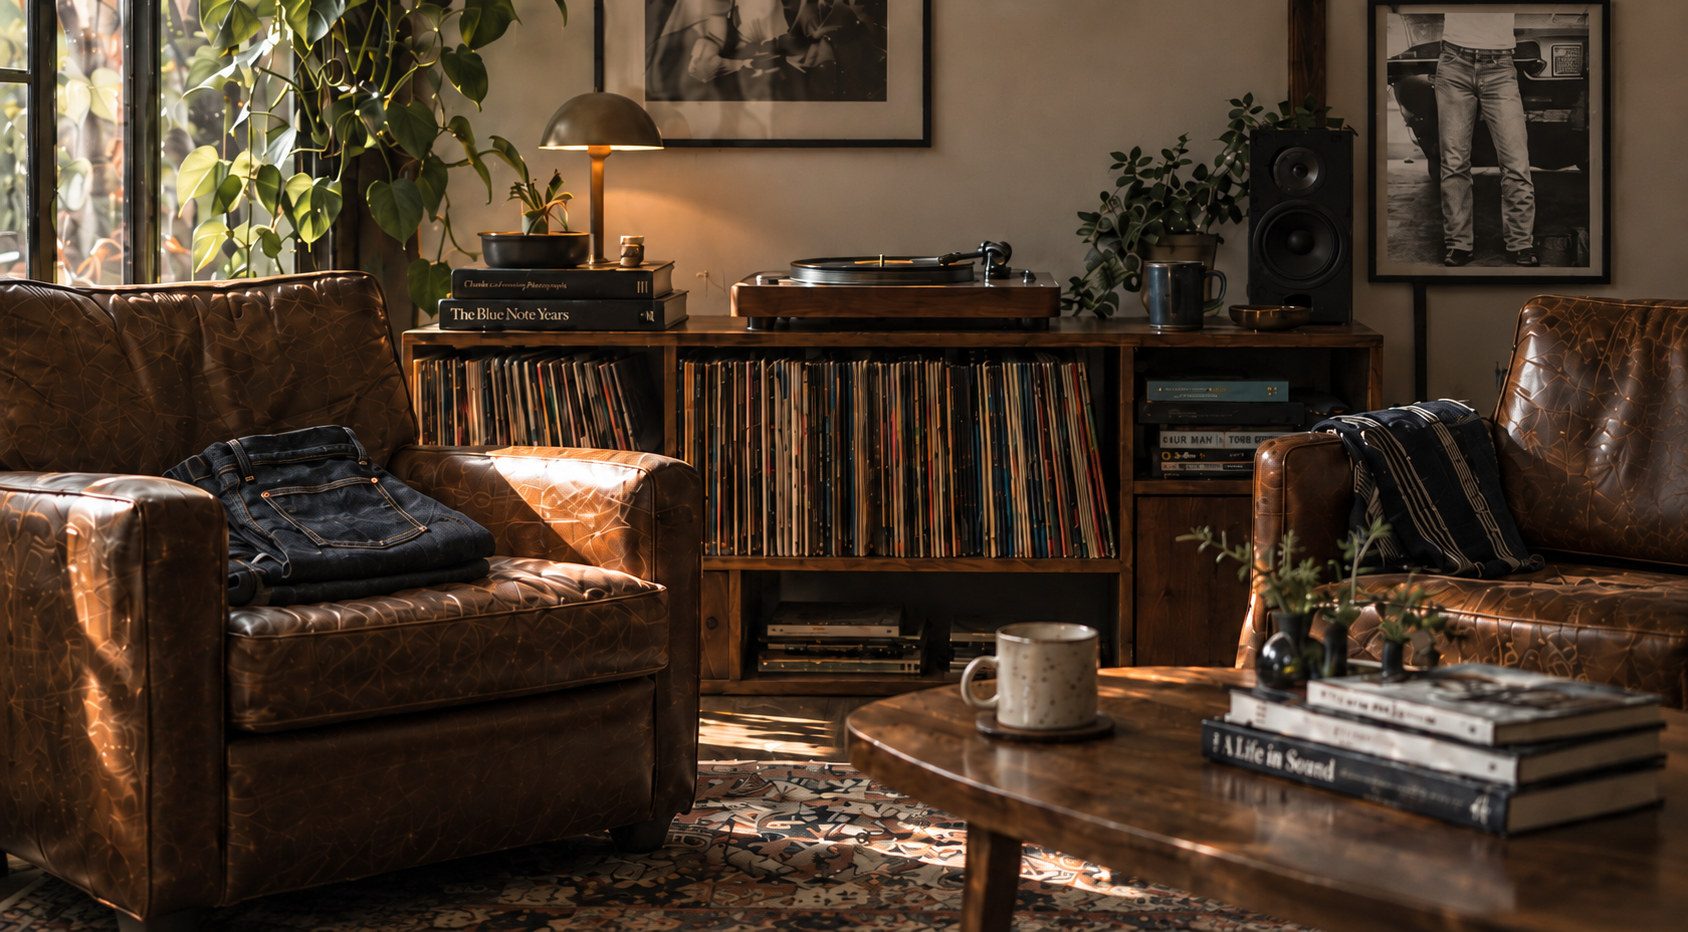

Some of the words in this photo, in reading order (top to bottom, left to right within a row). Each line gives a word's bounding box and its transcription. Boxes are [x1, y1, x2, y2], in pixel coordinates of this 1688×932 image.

[450, 307, 476, 320] The
[477, 307, 504, 321] Blue
[506, 307, 536, 321] Note
[537, 307, 570, 321] Years
[1223, 734, 1234, 757] A
[1235, 735, 1265, 765] Life
[1266, 743, 1283, 770] in
[1285, 748, 1336, 783] Sound
